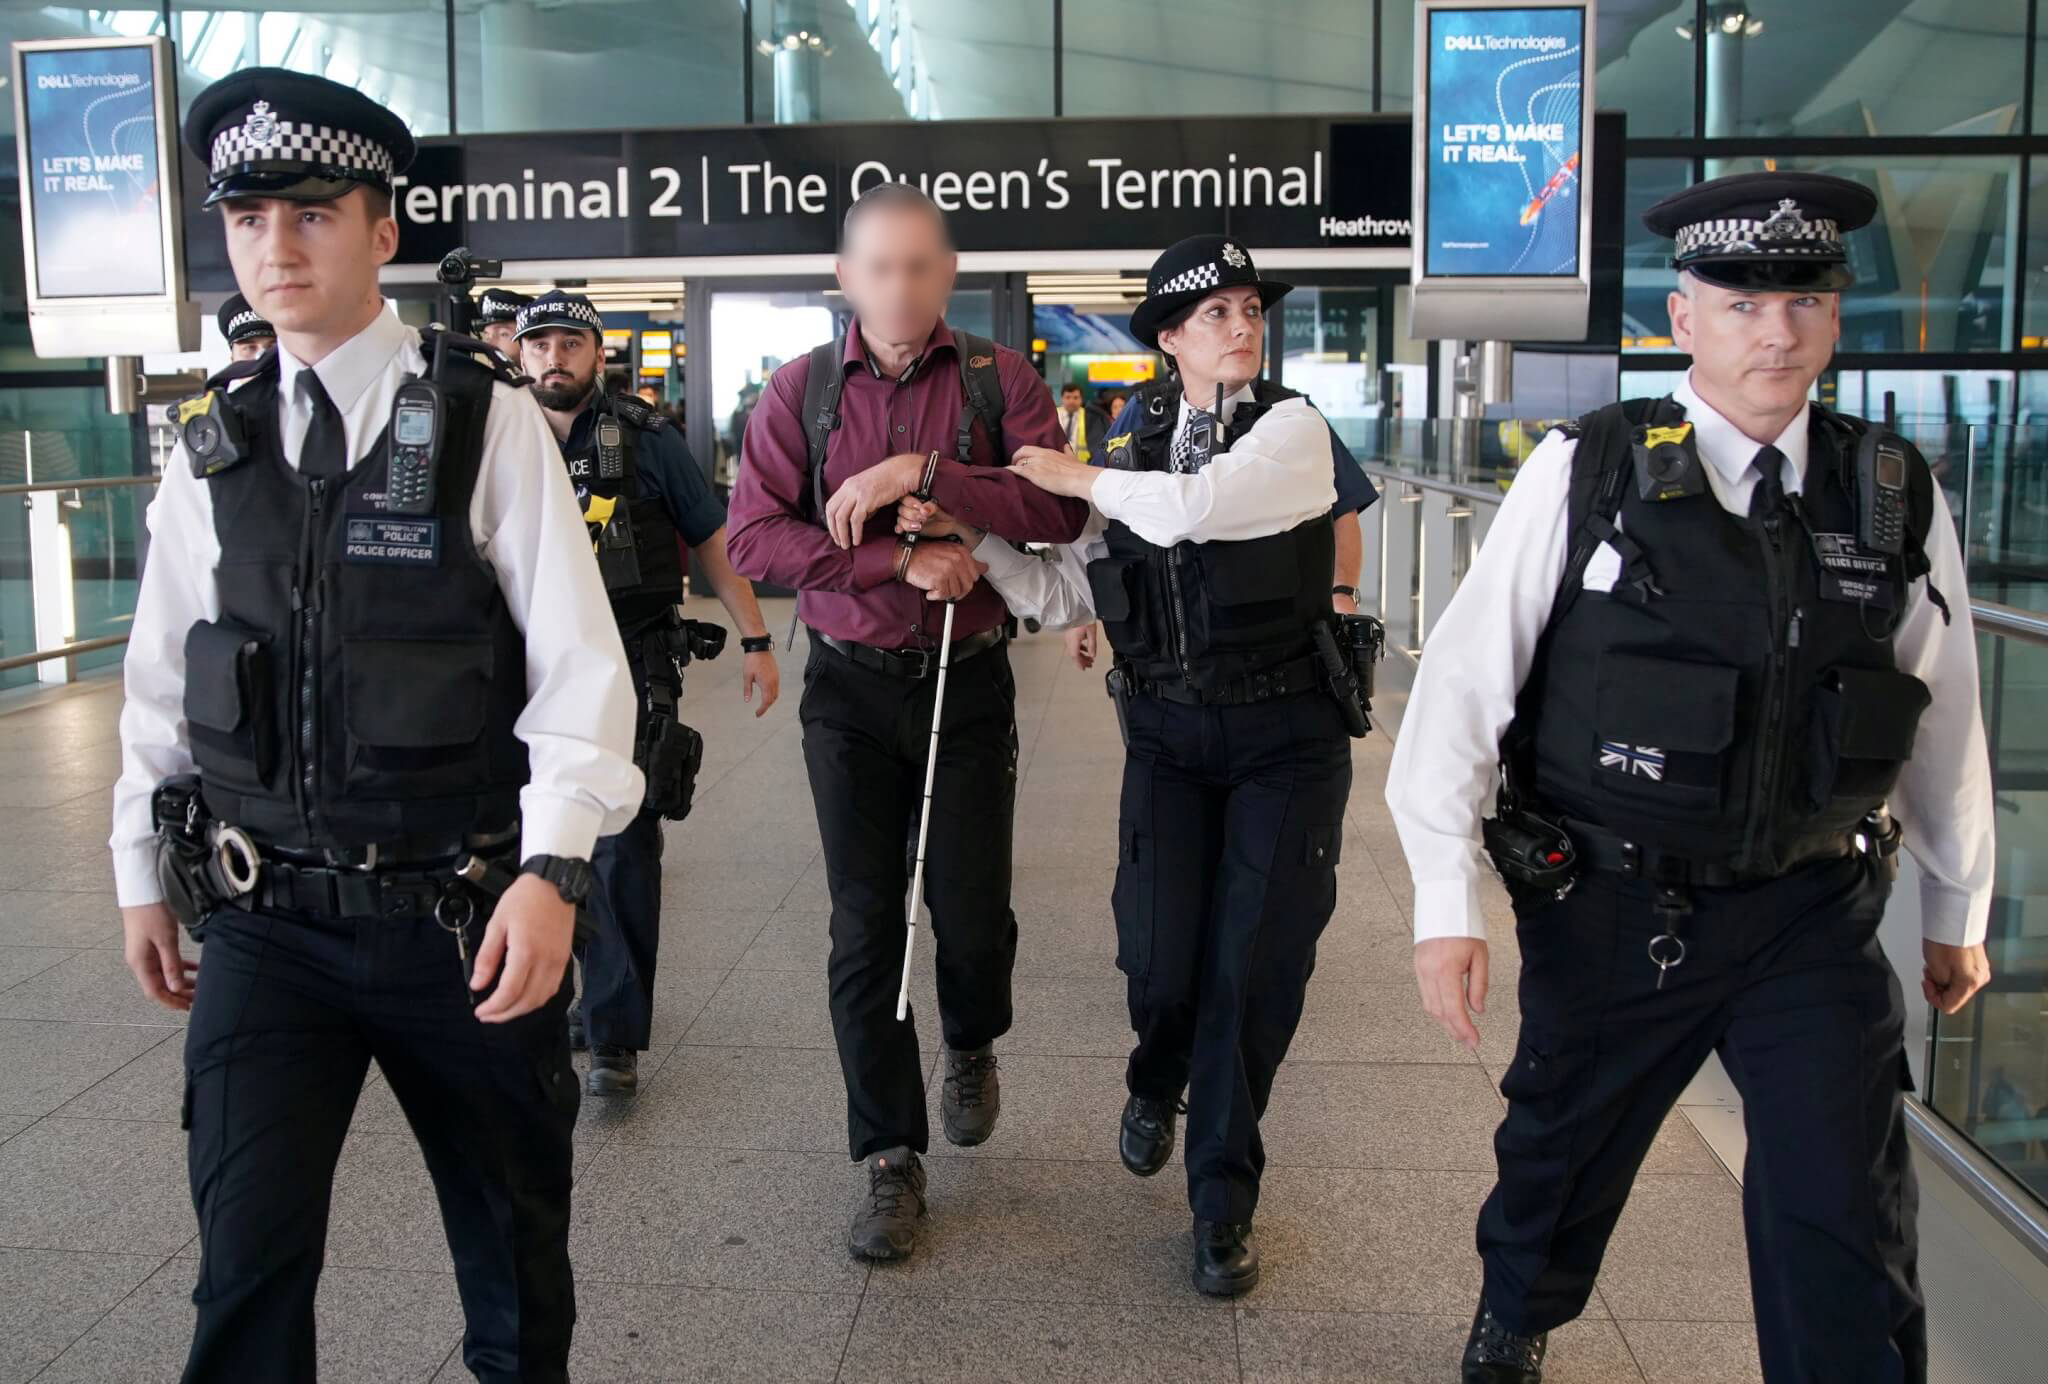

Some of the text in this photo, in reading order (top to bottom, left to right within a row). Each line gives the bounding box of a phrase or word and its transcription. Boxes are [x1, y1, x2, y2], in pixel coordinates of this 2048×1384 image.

[1443, 123, 1564, 142] LET'S MAKE
[1443, 145, 1527, 163] IT REAL.
[43, 154, 144, 174] LET'S MAKE
[44, 174, 114, 192] IT REAL.
[649, 166, 683, 217] 2
[727, 160, 828, 214] The
[1087, 150, 1322, 210] Terminal
[530, 302, 565, 317] POLICE
[568, 459, 590, 476] ICE
[383, 531, 420, 542] POLICE
[347, 544, 433, 559] POLICE OFFICER
[1824, 557, 1852, 569] OLICE
